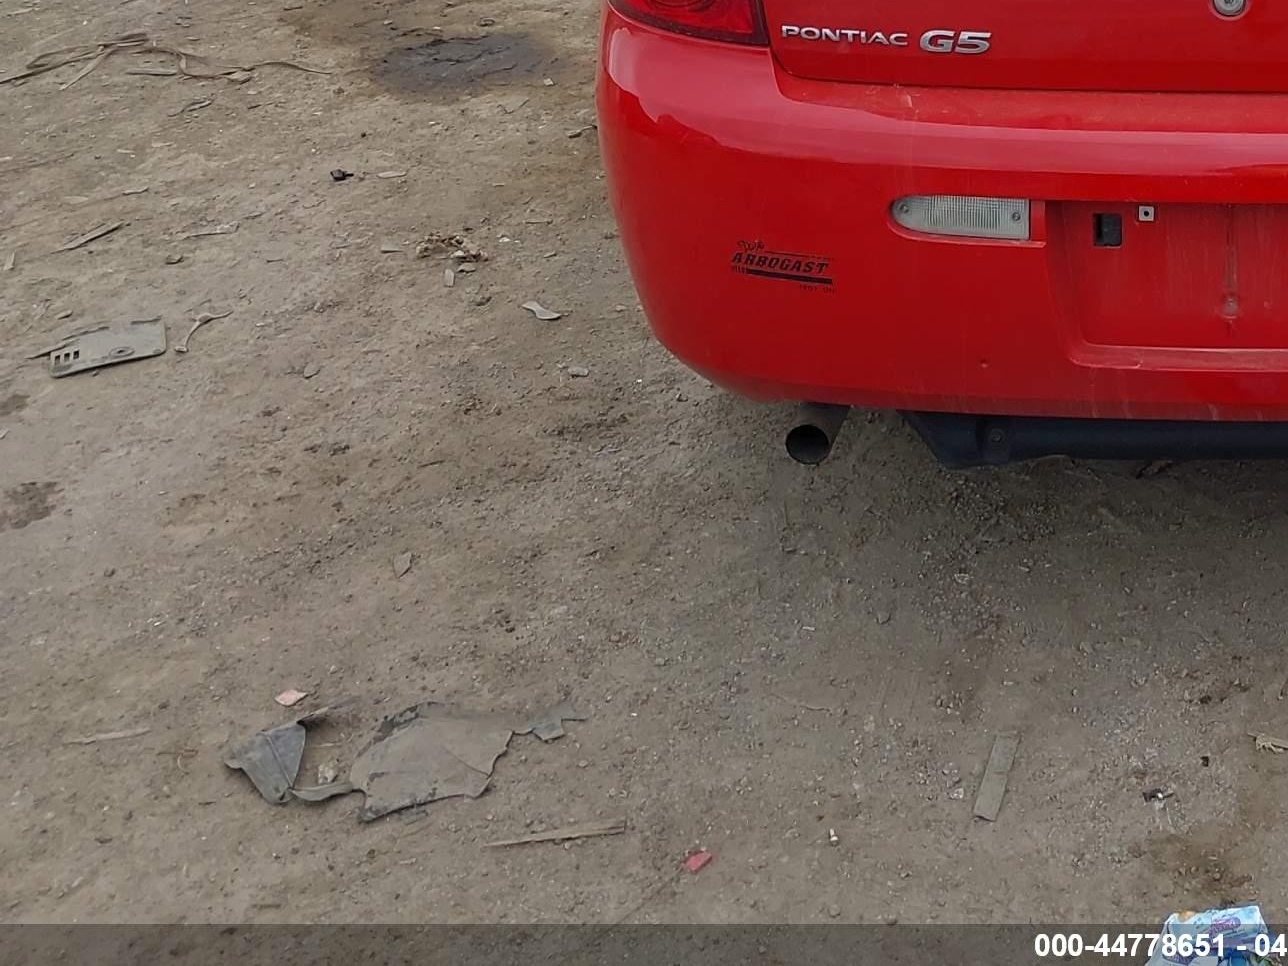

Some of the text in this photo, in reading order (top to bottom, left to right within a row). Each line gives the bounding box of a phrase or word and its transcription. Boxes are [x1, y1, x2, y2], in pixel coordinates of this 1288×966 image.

[781, 25, 992, 54] PONTIAC G5
[731, 252, 830, 275] ARBOGAST
